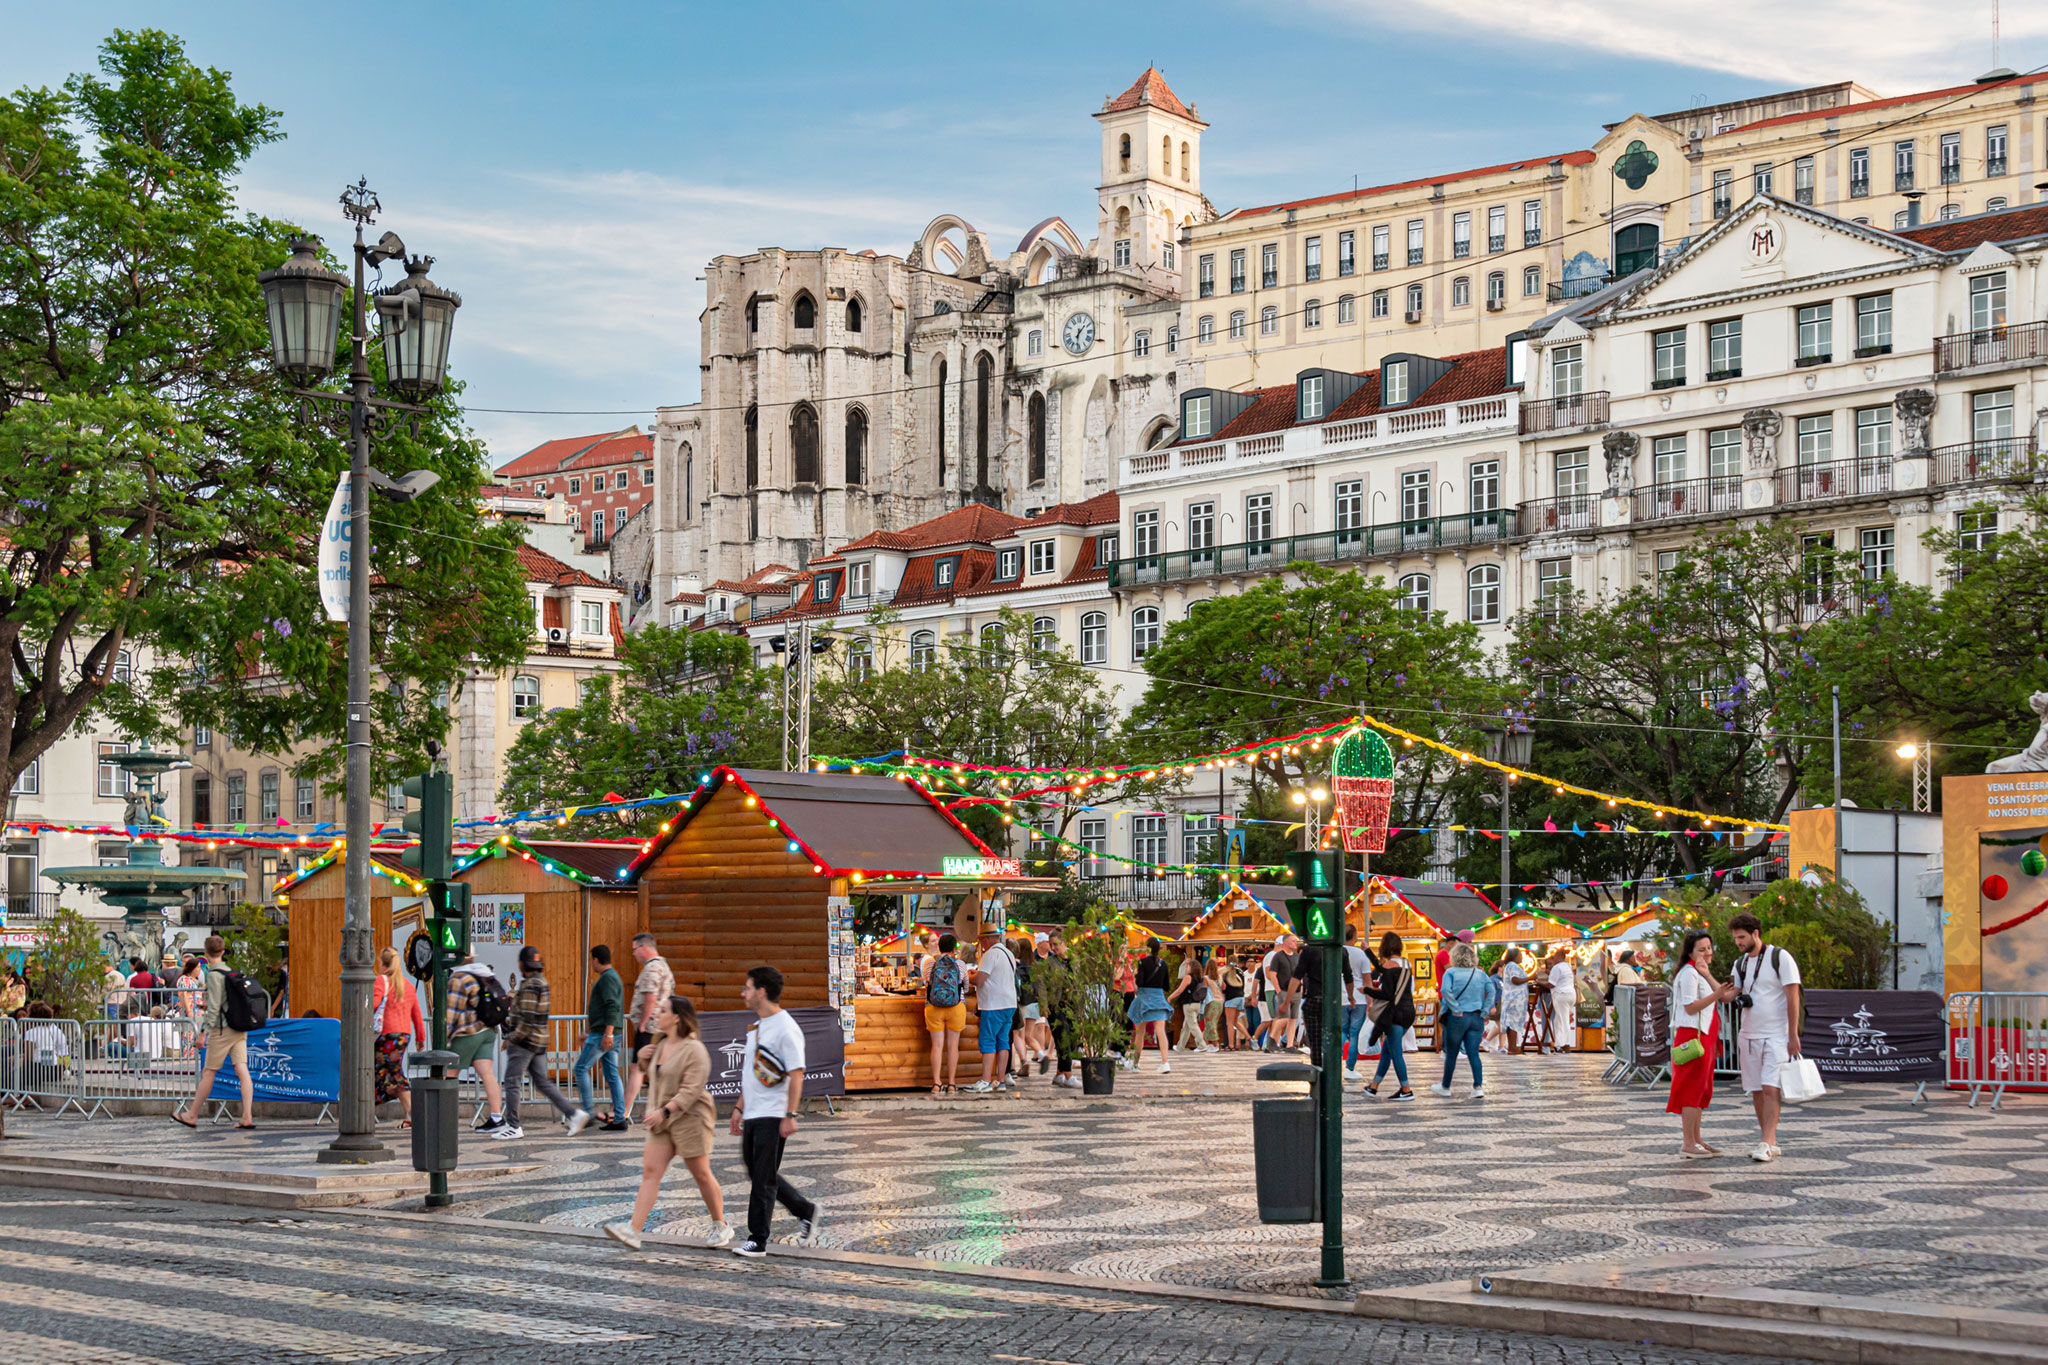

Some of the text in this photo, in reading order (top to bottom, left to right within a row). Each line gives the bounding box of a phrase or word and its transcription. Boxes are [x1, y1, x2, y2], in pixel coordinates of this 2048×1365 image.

[1987, 783, 2014, 792] VENHA
[1987, 796, 1999, 805] OS
[2000, 795, 2031, 804] SANTOS
[1988, 809, 2000, 817] NO
[2002, 808, 2029, 817] NOSSO
[944, 857, 1020, 877] HANDMADE
[477, 902, 495, 918] BICA
[477, 920, 495, 934] BICA!
[1857, 1057, 1918, 1066] DINAMIZAÇÃO
[711, 1088, 741, 1096] BAIXA
